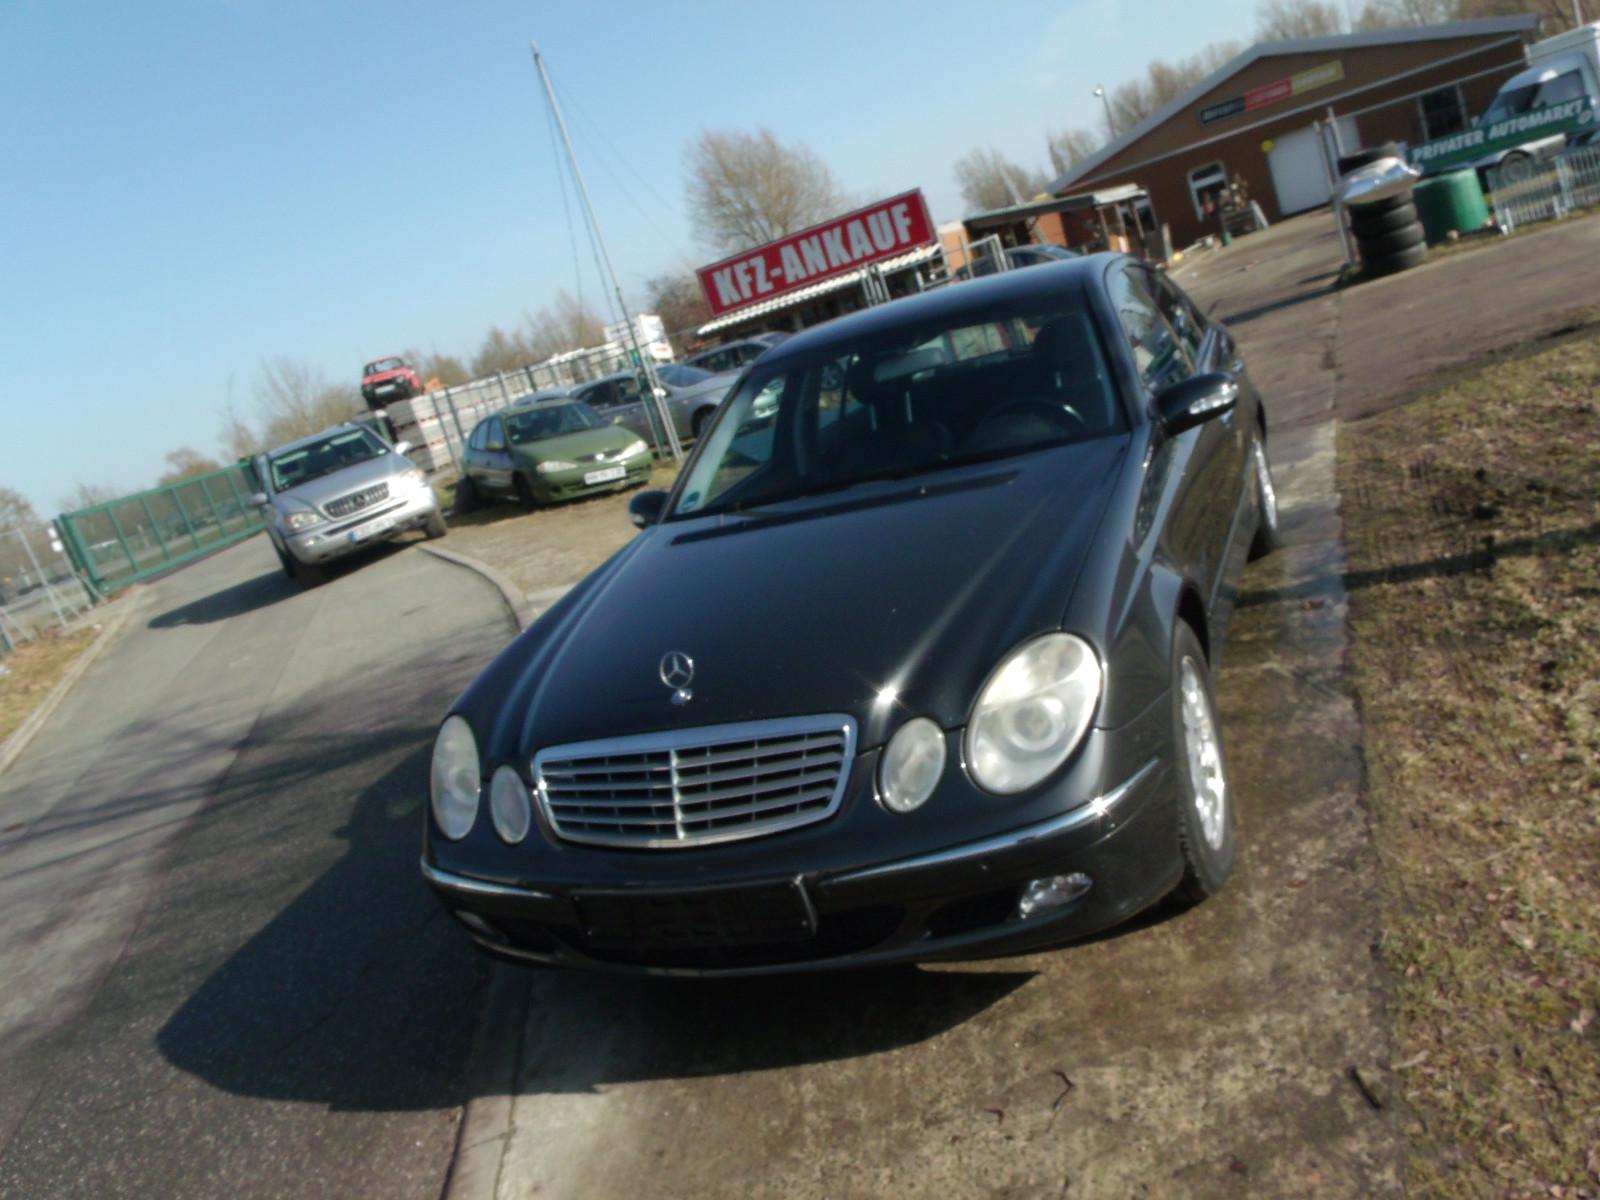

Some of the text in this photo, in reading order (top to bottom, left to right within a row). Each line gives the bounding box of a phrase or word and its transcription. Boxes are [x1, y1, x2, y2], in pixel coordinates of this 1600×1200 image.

[1412, 99, 1583, 161] PRIVATER AUTOMARKT
[712, 203, 912, 306] KFZ-ANKAUF
